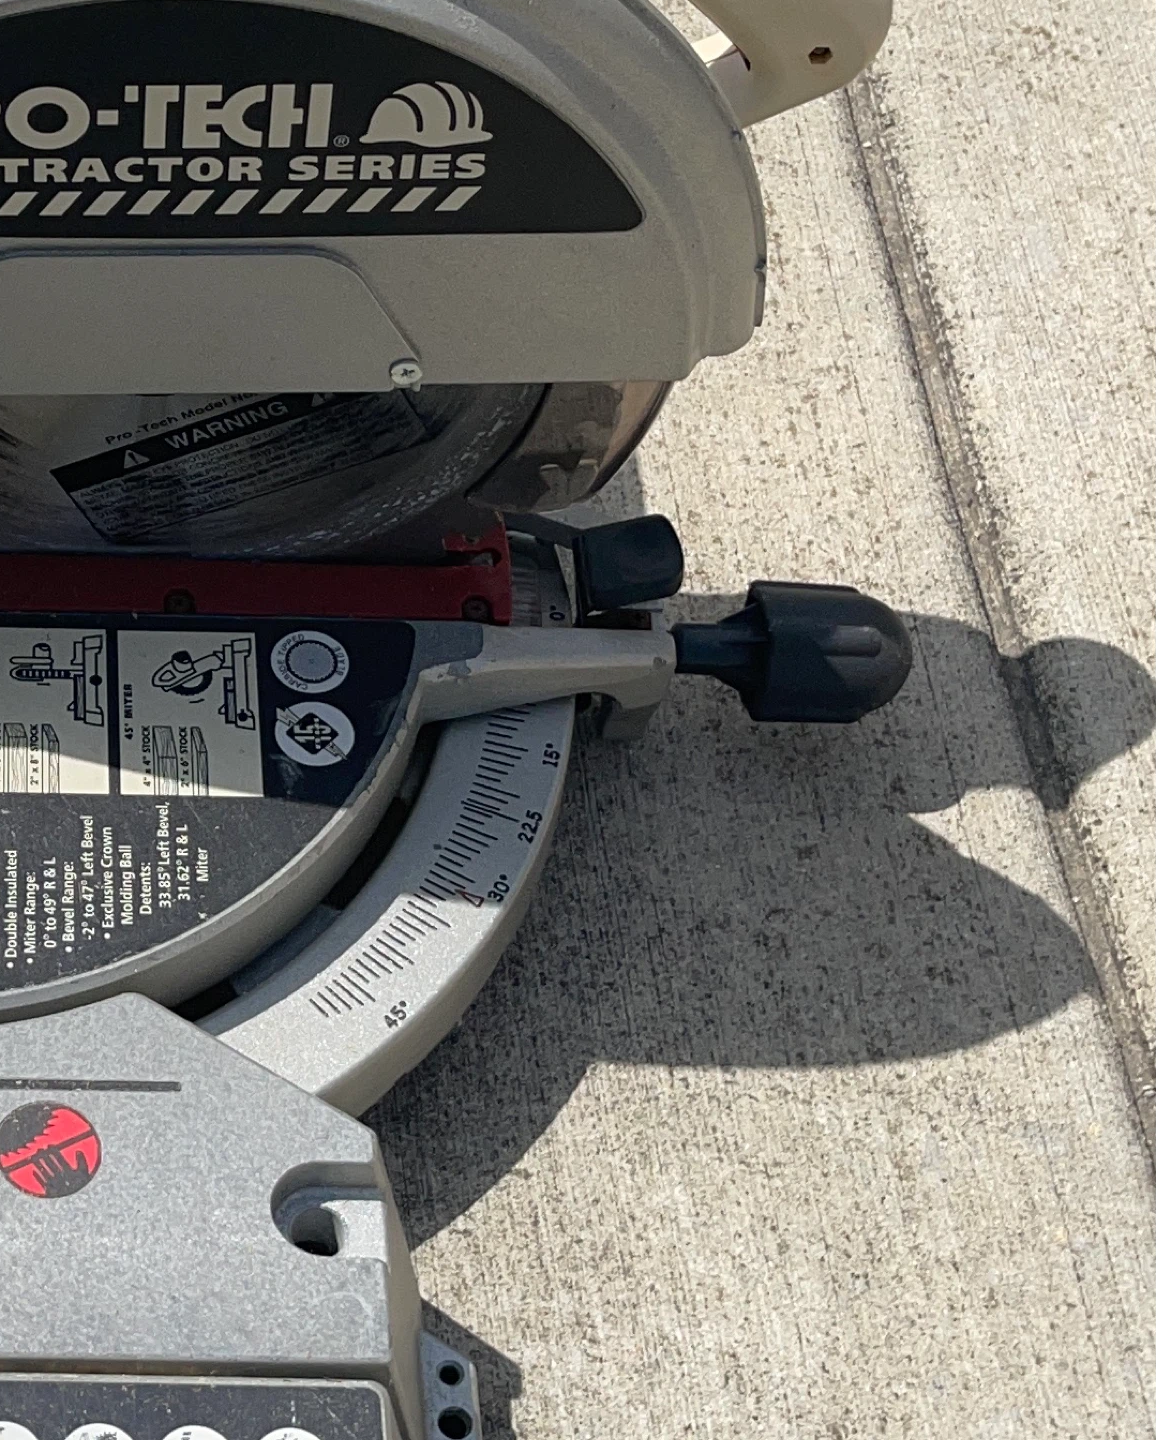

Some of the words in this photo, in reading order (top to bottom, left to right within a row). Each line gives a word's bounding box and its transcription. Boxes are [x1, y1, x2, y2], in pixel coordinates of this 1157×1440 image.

[288, 153, 486, 181] SERIES
[181, 398, 228, 420] Model
[164, 401, 289, 449] WARNING
[124, 684, 133, 718] MITER
[30, 724, 38, 751] STOCK
[142, 726, 150, 753] STOCK
[179, 727, 188, 753] STOCK
[542, 742, 559, 768] 15°
[80, 815, 93, 848] Bevel
[156, 802, 170, 837] Bevel,
[518, 810, 543, 844] 22.5
[101, 827, 112, 867] Crown
[157, 841, 170, 865] Left
[176, 835, 188, 844] &
[177, 848, 188, 856] R
[80, 852, 94, 876] Left
[119, 845, 132, 867] Ball
[196, 847, 208, 882] Miter
[4, 850, 17, 908] Insulated
[44, 868, 56, 878] &
[44, 881, 56, 889] R
[63, 862, 77, 904] Range:
[24, 872, 39, 915] Range:
[101, 872, 114, 928] Exclusive
[121, 872, 136, 925] Molding
[139, 862, 152, 915] Detents:
[487, 874, 509, 902] 30°
[45, 917, 56, 930] to
[62, 908, 74, 941] Bevel
[83, 904, 94, 917] to
[4, 912, 17, 958] Double
[24, 918, 36, 954] Miter
[384, 1000, 407, 1029] 45°
